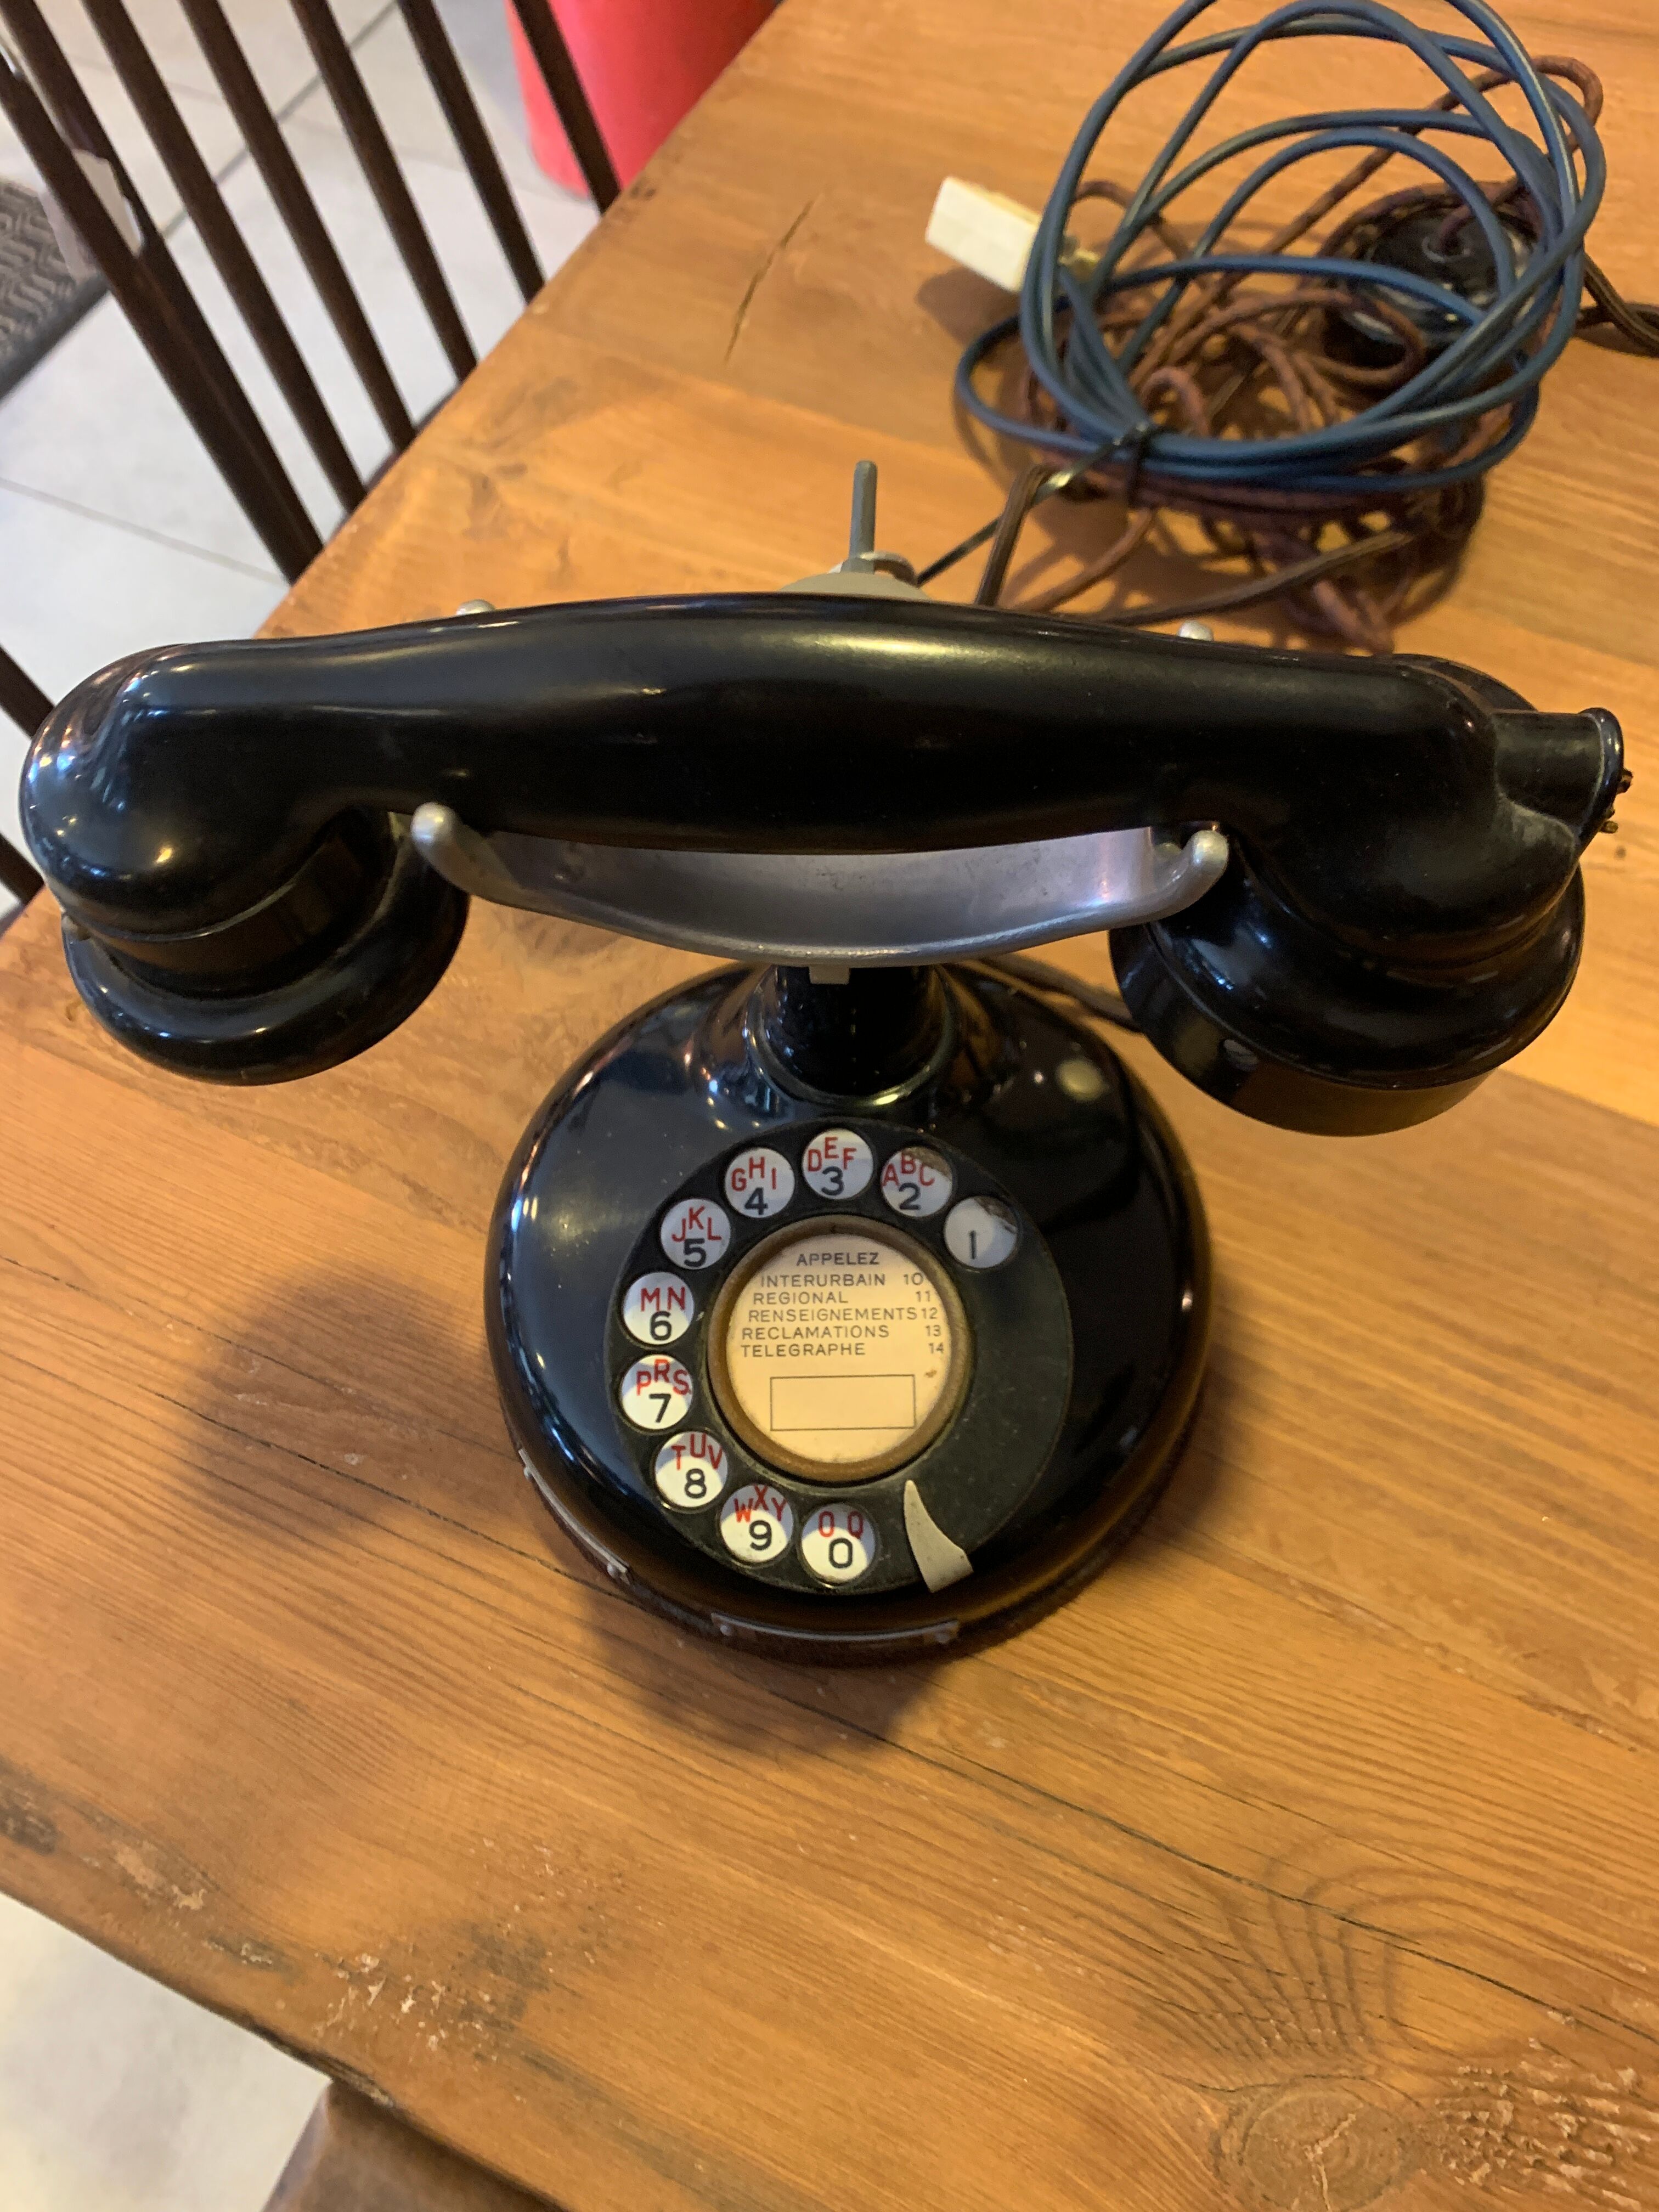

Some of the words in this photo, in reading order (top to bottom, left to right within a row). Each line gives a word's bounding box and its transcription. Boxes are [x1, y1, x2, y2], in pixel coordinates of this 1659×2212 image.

[807, 1137, 857, 1172] DEF
[882, 1152, 935, 1187] ABC
[731, 1156, 777, 1192] GHI
[821, 1166, 844, 1196] 3
[744, 1187, 768, 1215] 4
[898, 1182, 921, 1210] 2
[671, 1205, 722, 1243] JKL
[683, 1238, 707, 1267] 5
[797, 1251, 880, 1266] APPELEZ
[761, 1273, 885, 1288] INTERURBAIN
[903, 1272, 924, 1285] 10
[641, 1286, 686, 1312] MN
[753, 1291, 849, 1305] REGIONAL
[916, 1290, 931, 1302] 11
[650, 1311, 672, 1341] 6
[748, 1307, 917, 1323] RENSEIGNEMENTS
[921, 1307, 938, 1320] 12
[742, 1324, 890, 1340] RECLAMATIONS
[926, 1324, 941, 1338] 13
[741, 1342, 866, 1357] TELEGRAPHE
[929, 1342, 945, 1355] 14
[636, 1358, 690, 1396] PRS
[649, 1393, 672, 1423] 7
[672, 1433, 723, 1470] TUV
[684, 1468, 707, 1499] 8
[734, 1483, 787, 1523] WXY
[749, 1520, 772, 1550] 9
[828, 1538, 853, 1569] 0
